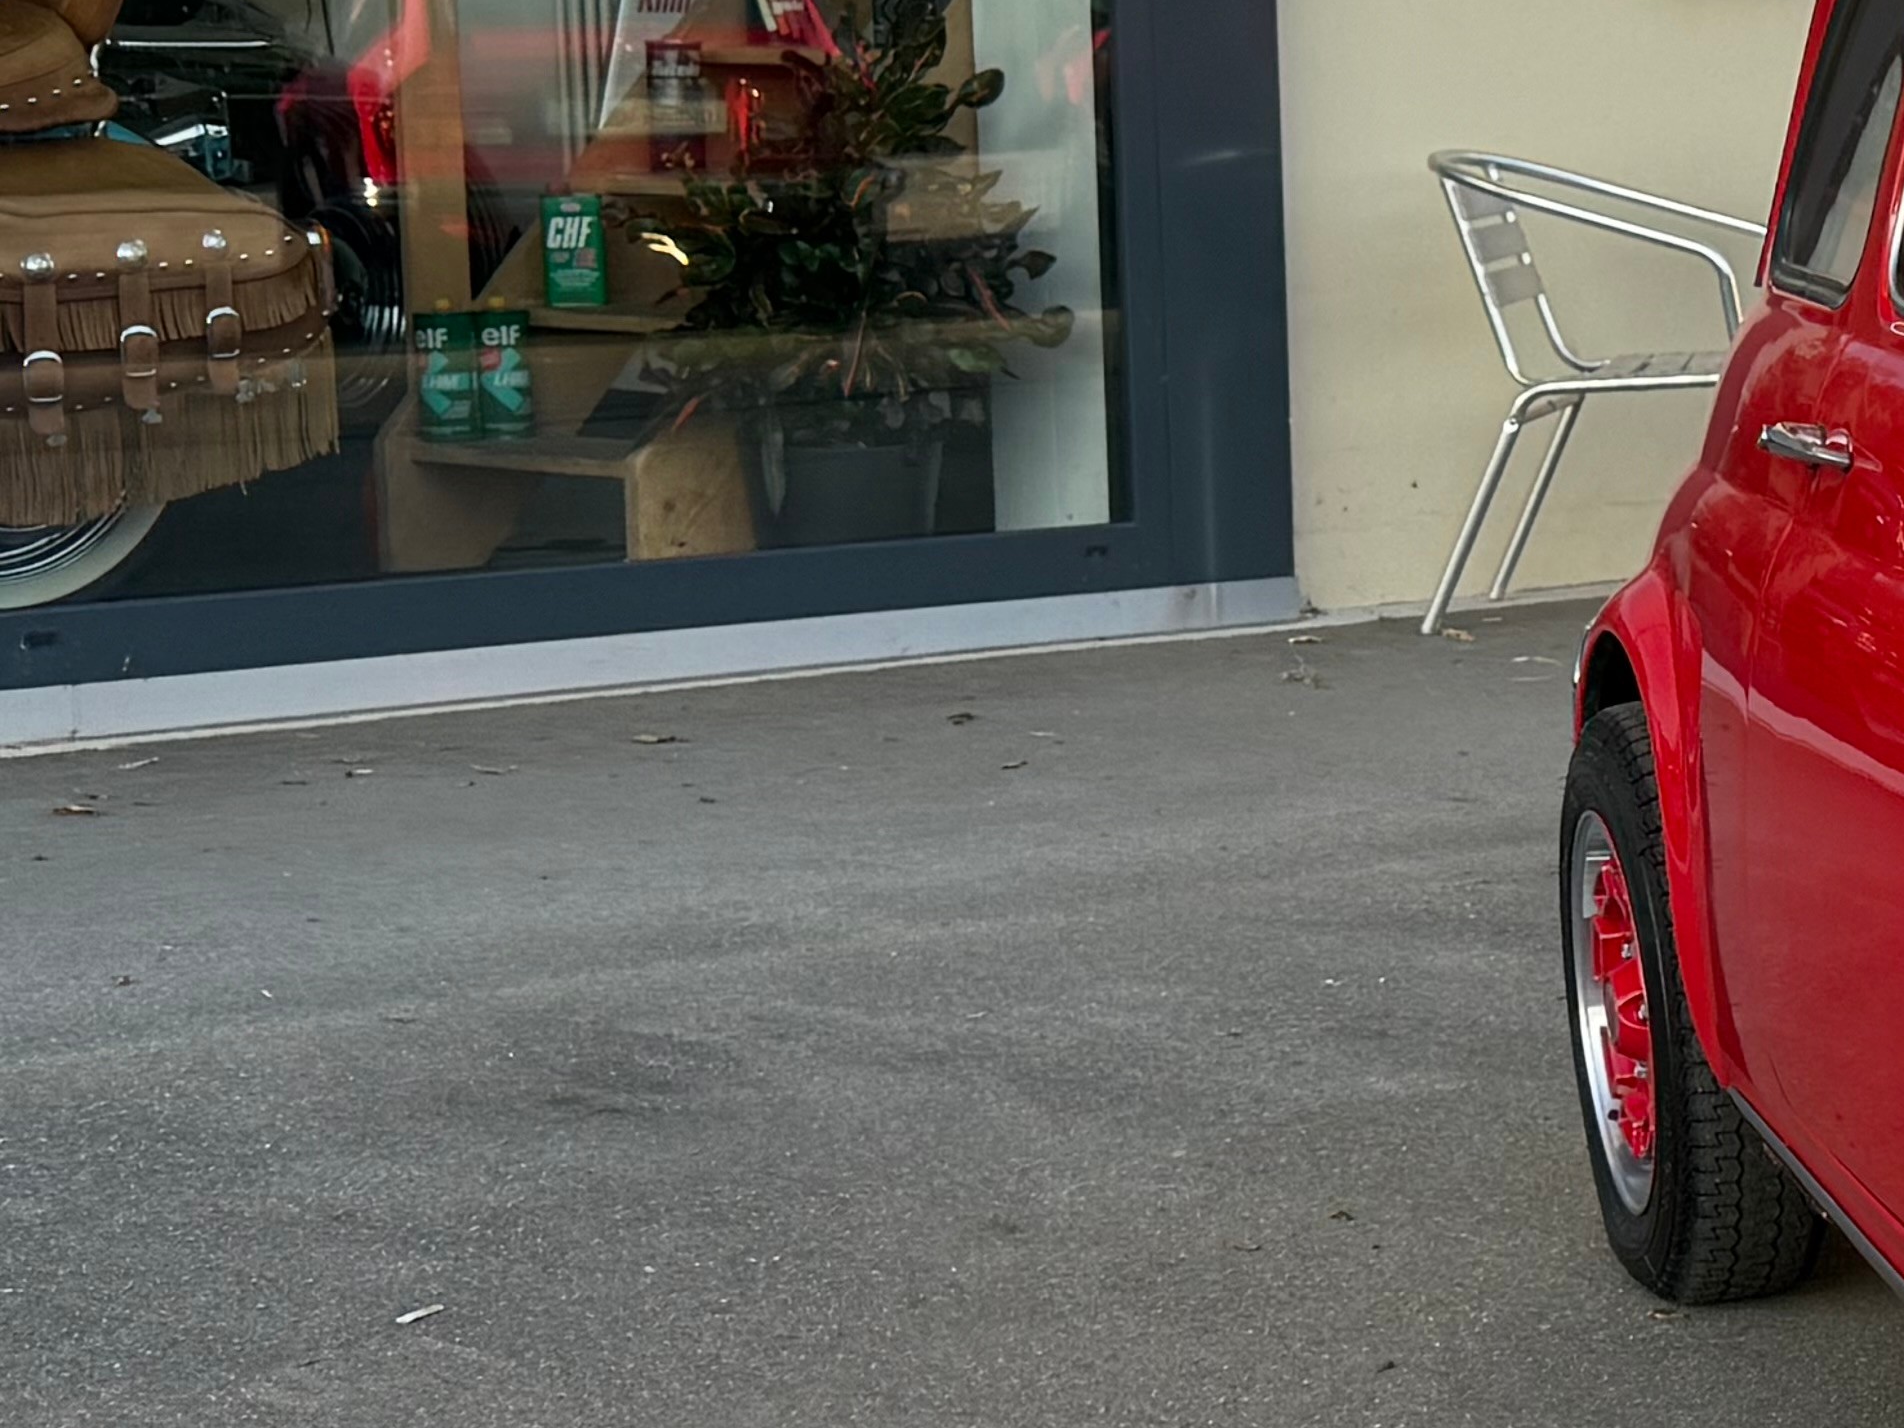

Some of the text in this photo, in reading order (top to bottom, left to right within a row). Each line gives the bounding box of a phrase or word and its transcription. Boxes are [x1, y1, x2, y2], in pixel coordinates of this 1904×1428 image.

[546, 216, 592, 249] CHF
[416, 325, 520, 349] elf elf
